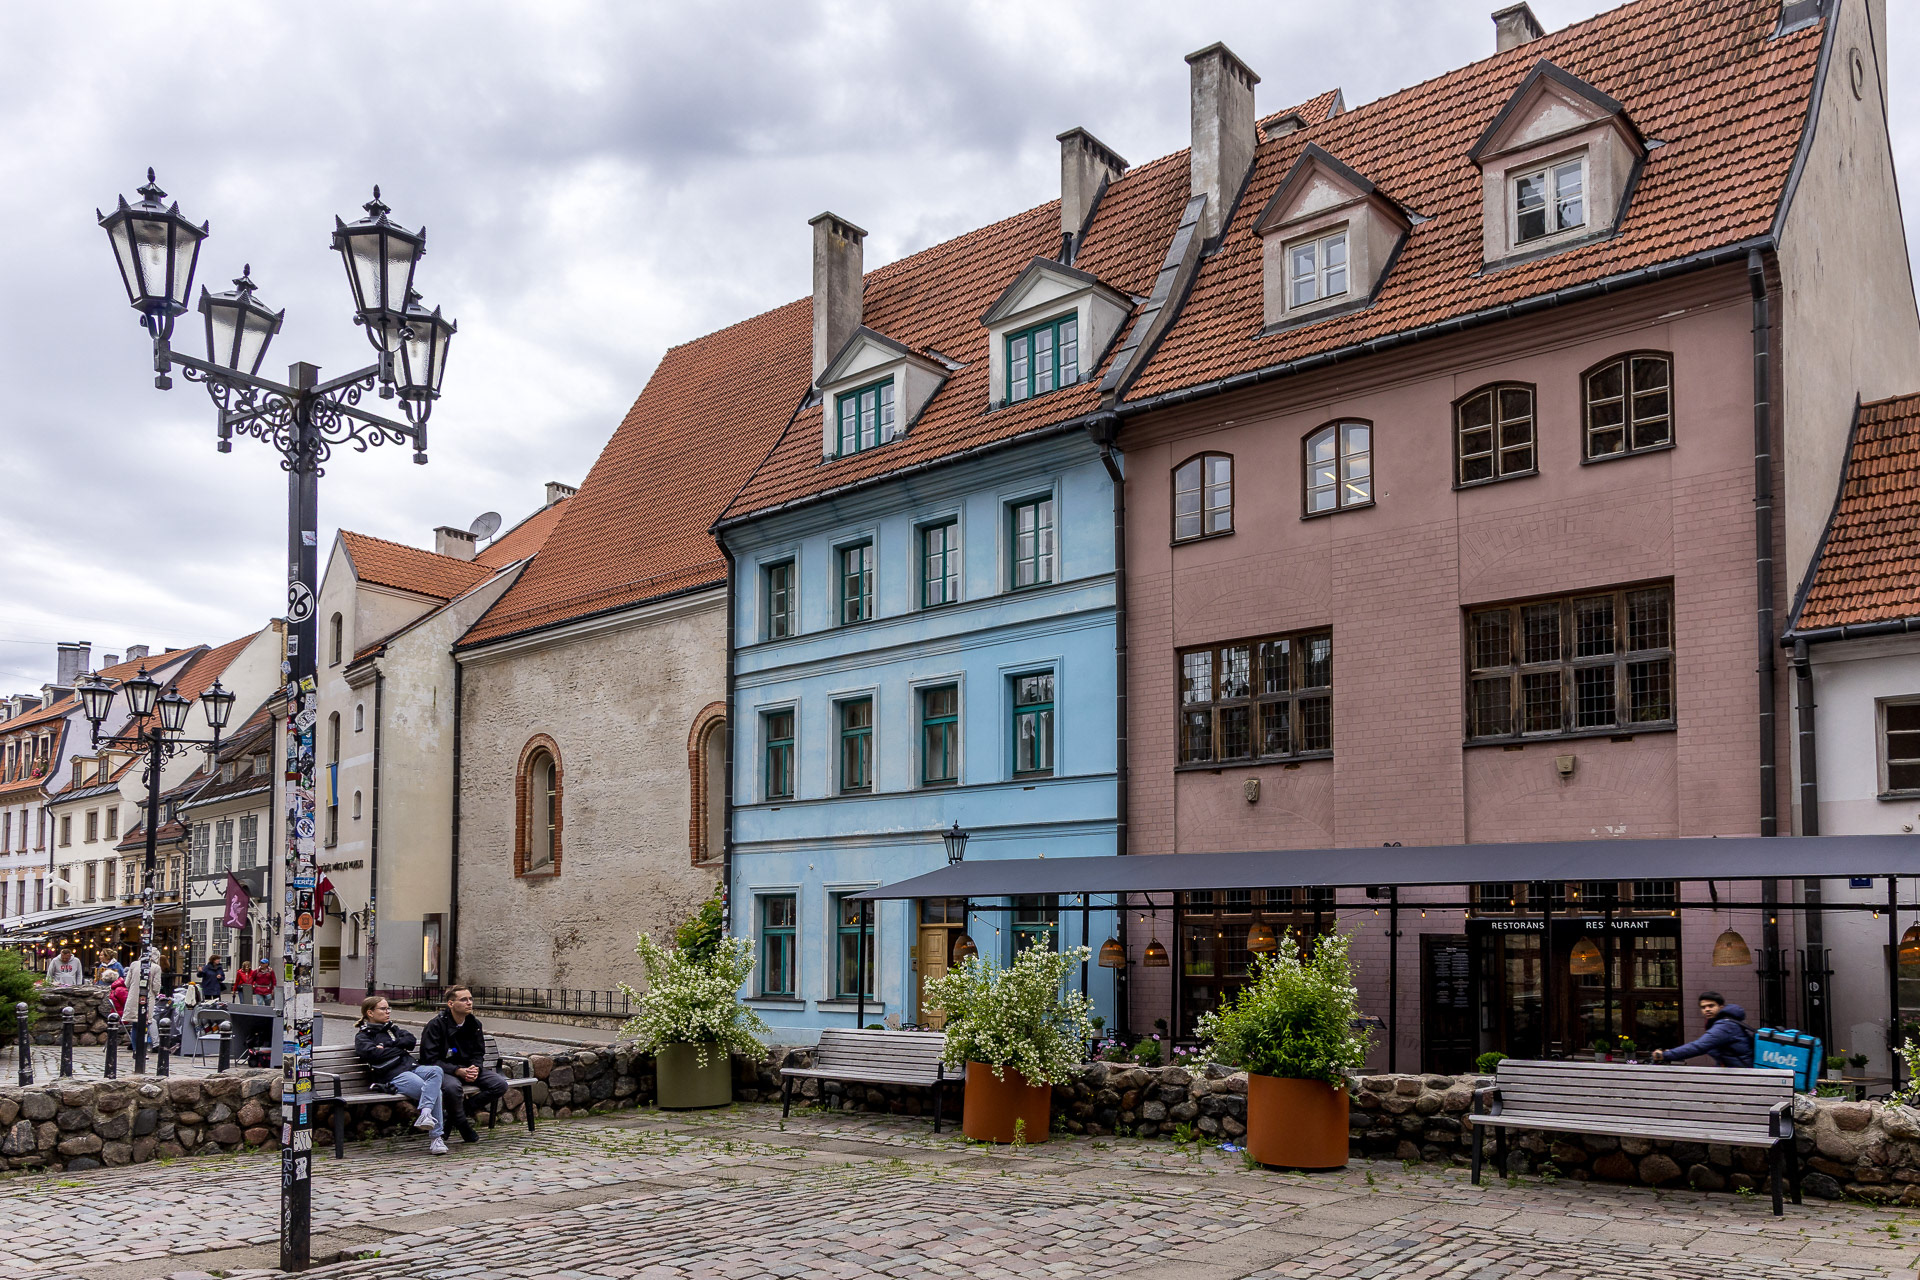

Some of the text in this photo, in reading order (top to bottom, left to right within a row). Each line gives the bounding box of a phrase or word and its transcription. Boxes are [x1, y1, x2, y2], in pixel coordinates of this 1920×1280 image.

[288, 587, 311, 617] 96
[1491, 920, 1650, 930] RESTORĀNS RESAURANT
[1762, 1050, 1799, 1067] Wolt
